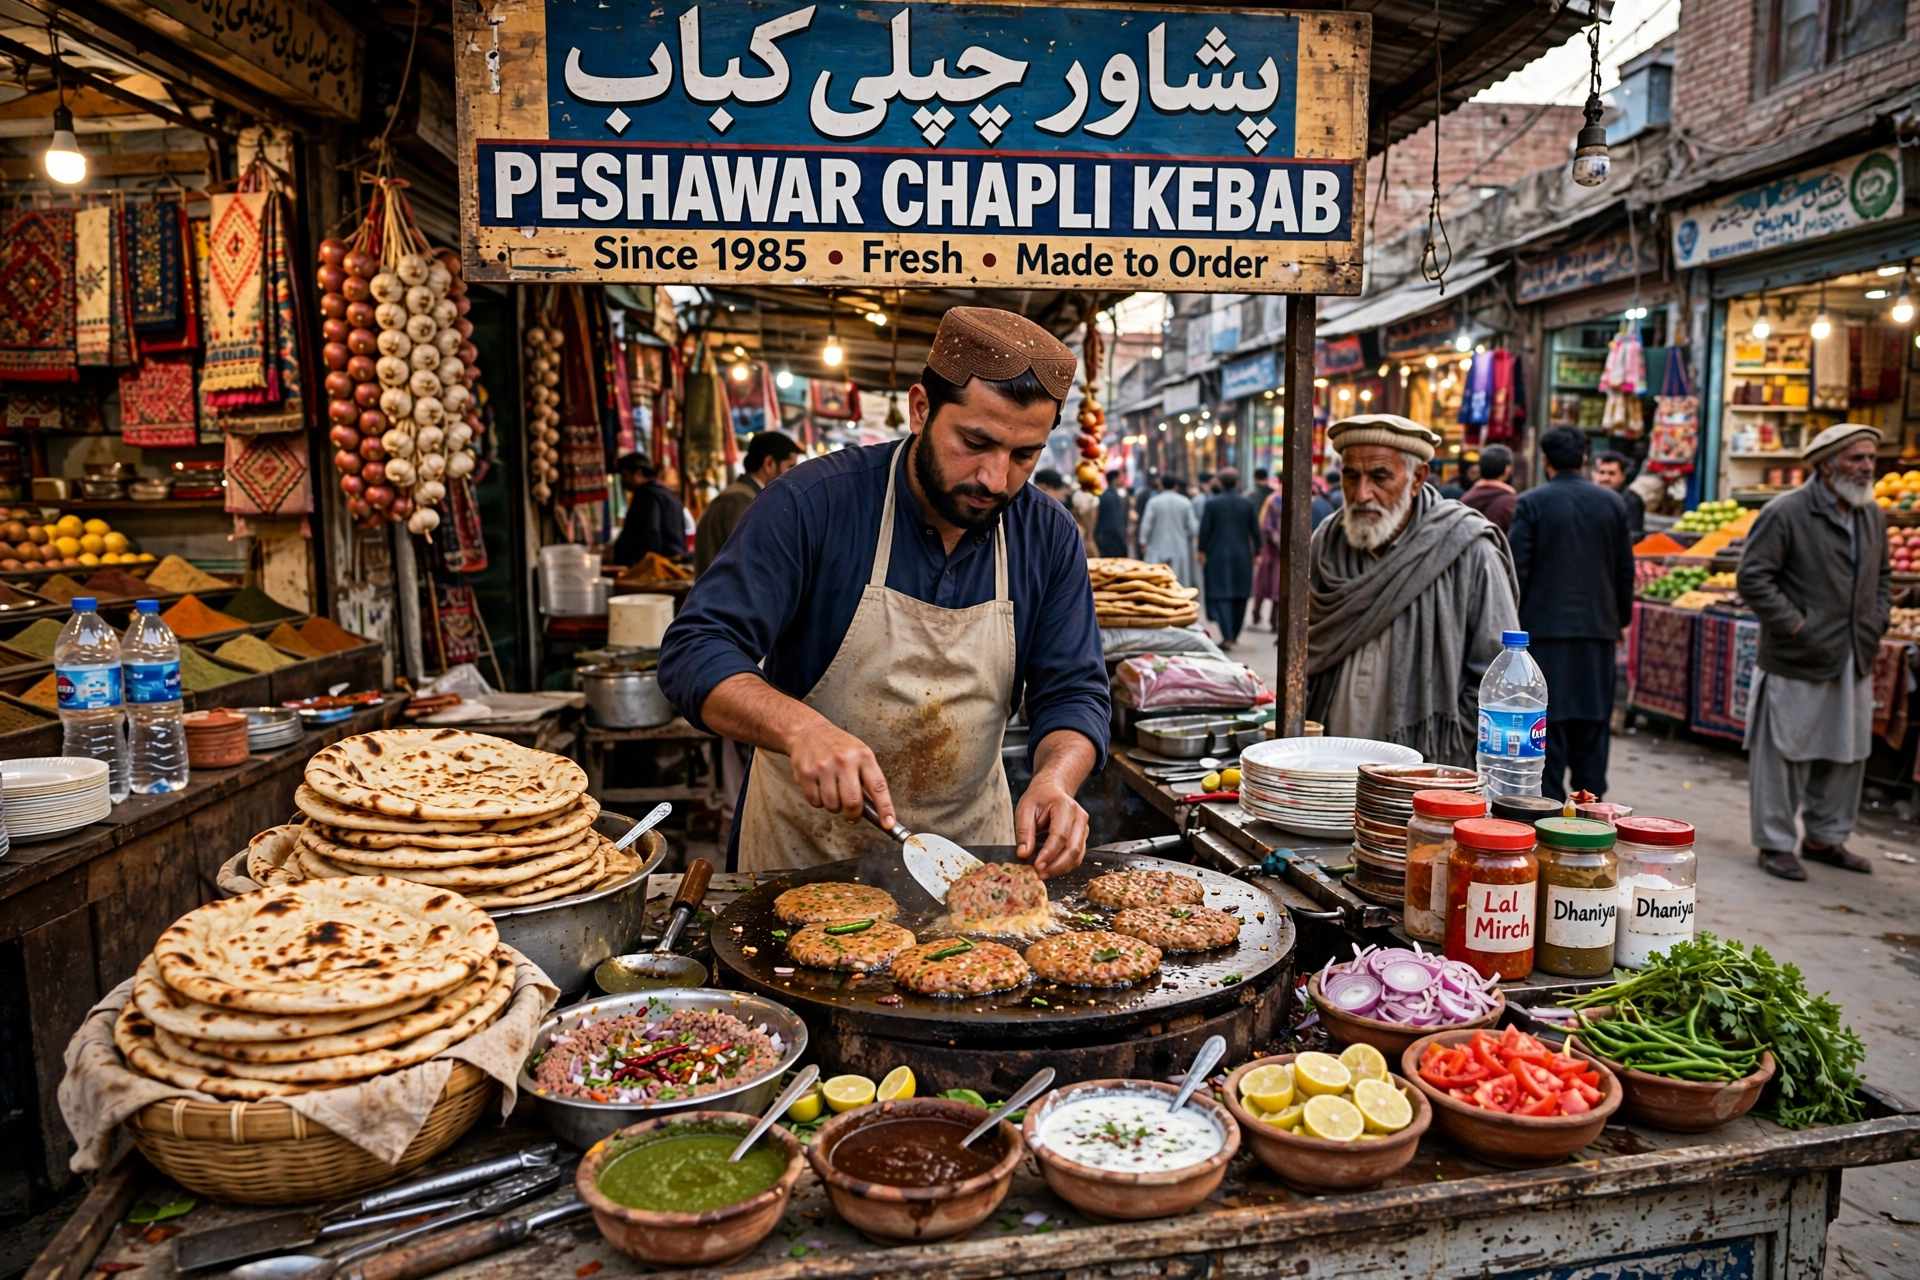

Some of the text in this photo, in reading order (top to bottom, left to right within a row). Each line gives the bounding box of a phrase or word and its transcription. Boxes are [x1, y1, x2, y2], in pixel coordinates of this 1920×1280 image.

[564, 5, 1279, 154] پشاور چپلی کباب
[495, 152, 1341, 233] PESHAWAR CHAPLI KEBAB
[594, 236, 1269, 279] Since 1985 Fresh Made to Order
[1484, 890, 1519, 913] Lal
[1553, 899, 1616, 928] Dhaniya
[1636, 897, 1695, 924] Dhaniya
[1474, 914, 1530, 941] Mirch
